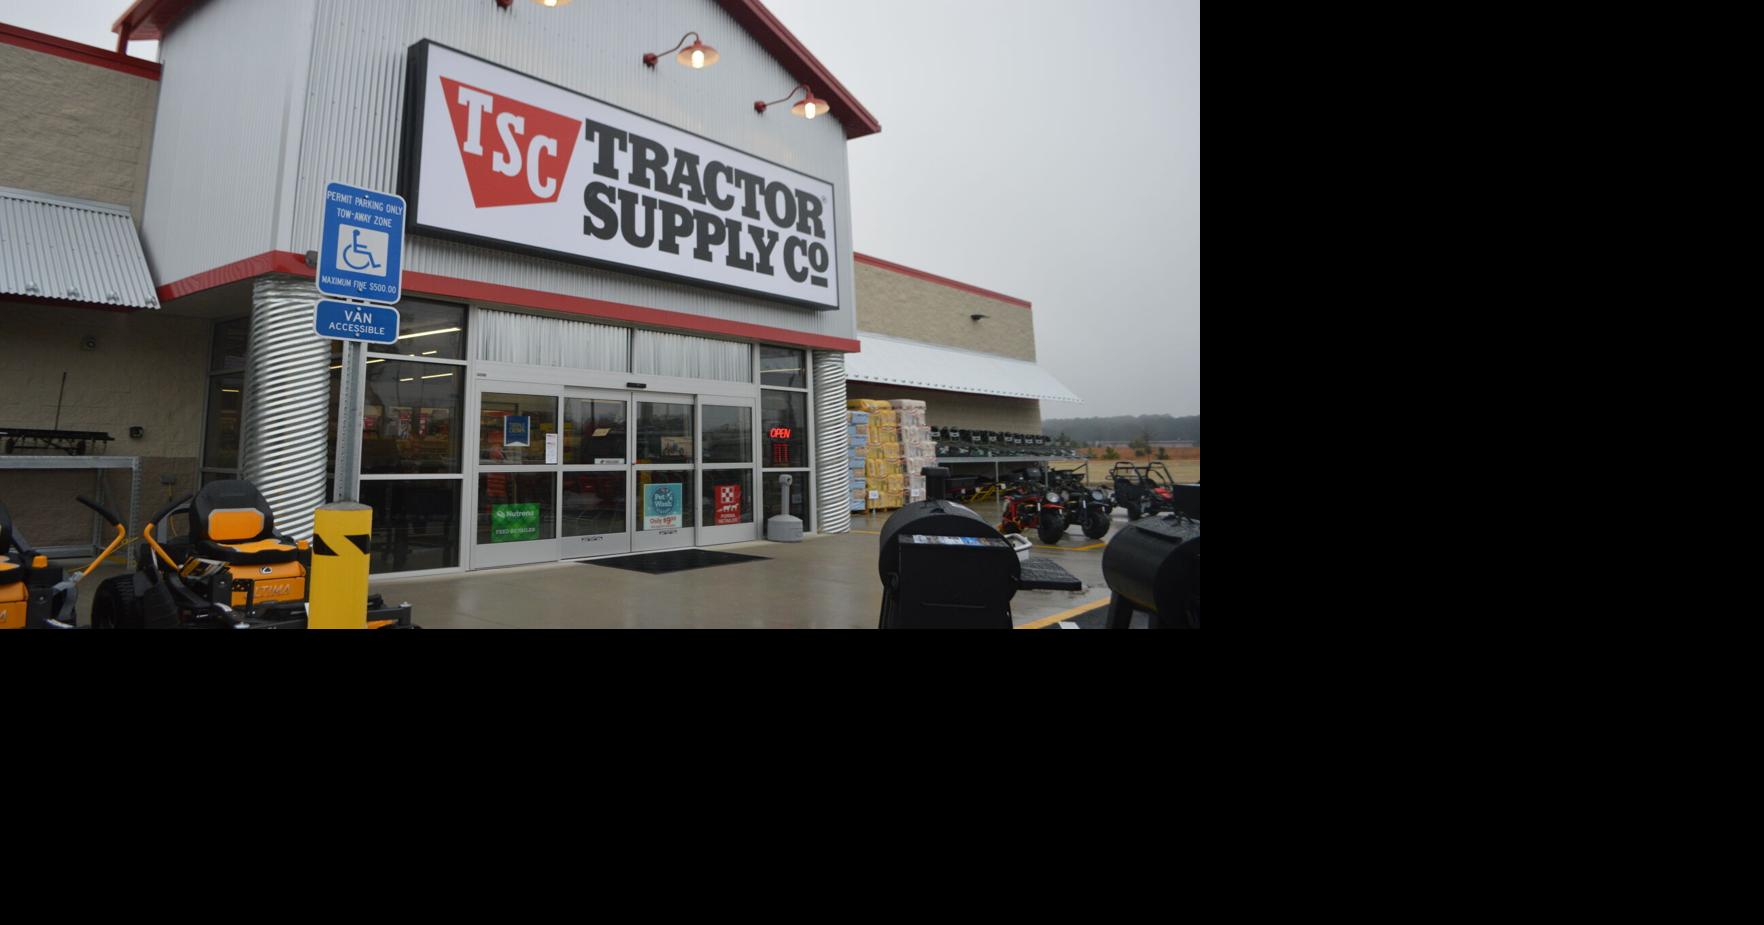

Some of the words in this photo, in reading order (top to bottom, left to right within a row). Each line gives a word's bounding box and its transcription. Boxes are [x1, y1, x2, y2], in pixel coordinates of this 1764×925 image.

[458, 86, 558, 198] TSC
[585, 118, 826, 239] TRACTOR
[327, 190, 352, 205] PERMIT
[355, 196, 384, 212] PARKING
[386, 203, 403, 216] ONLY
[337, 208, 372, 223] TOW-AWAY
[374, 215, 392, 228] ZONE
[583, 181, 779, 277] SUPPLY
[321, 275, 352, 287] MAXIMUM
[353, 279, 367, 290] FINE
[344, 310, 372, 324] VAN
[329, 322, 385, 335] ACCESSIBLE
[770, 427, 791, 438] OPEN
